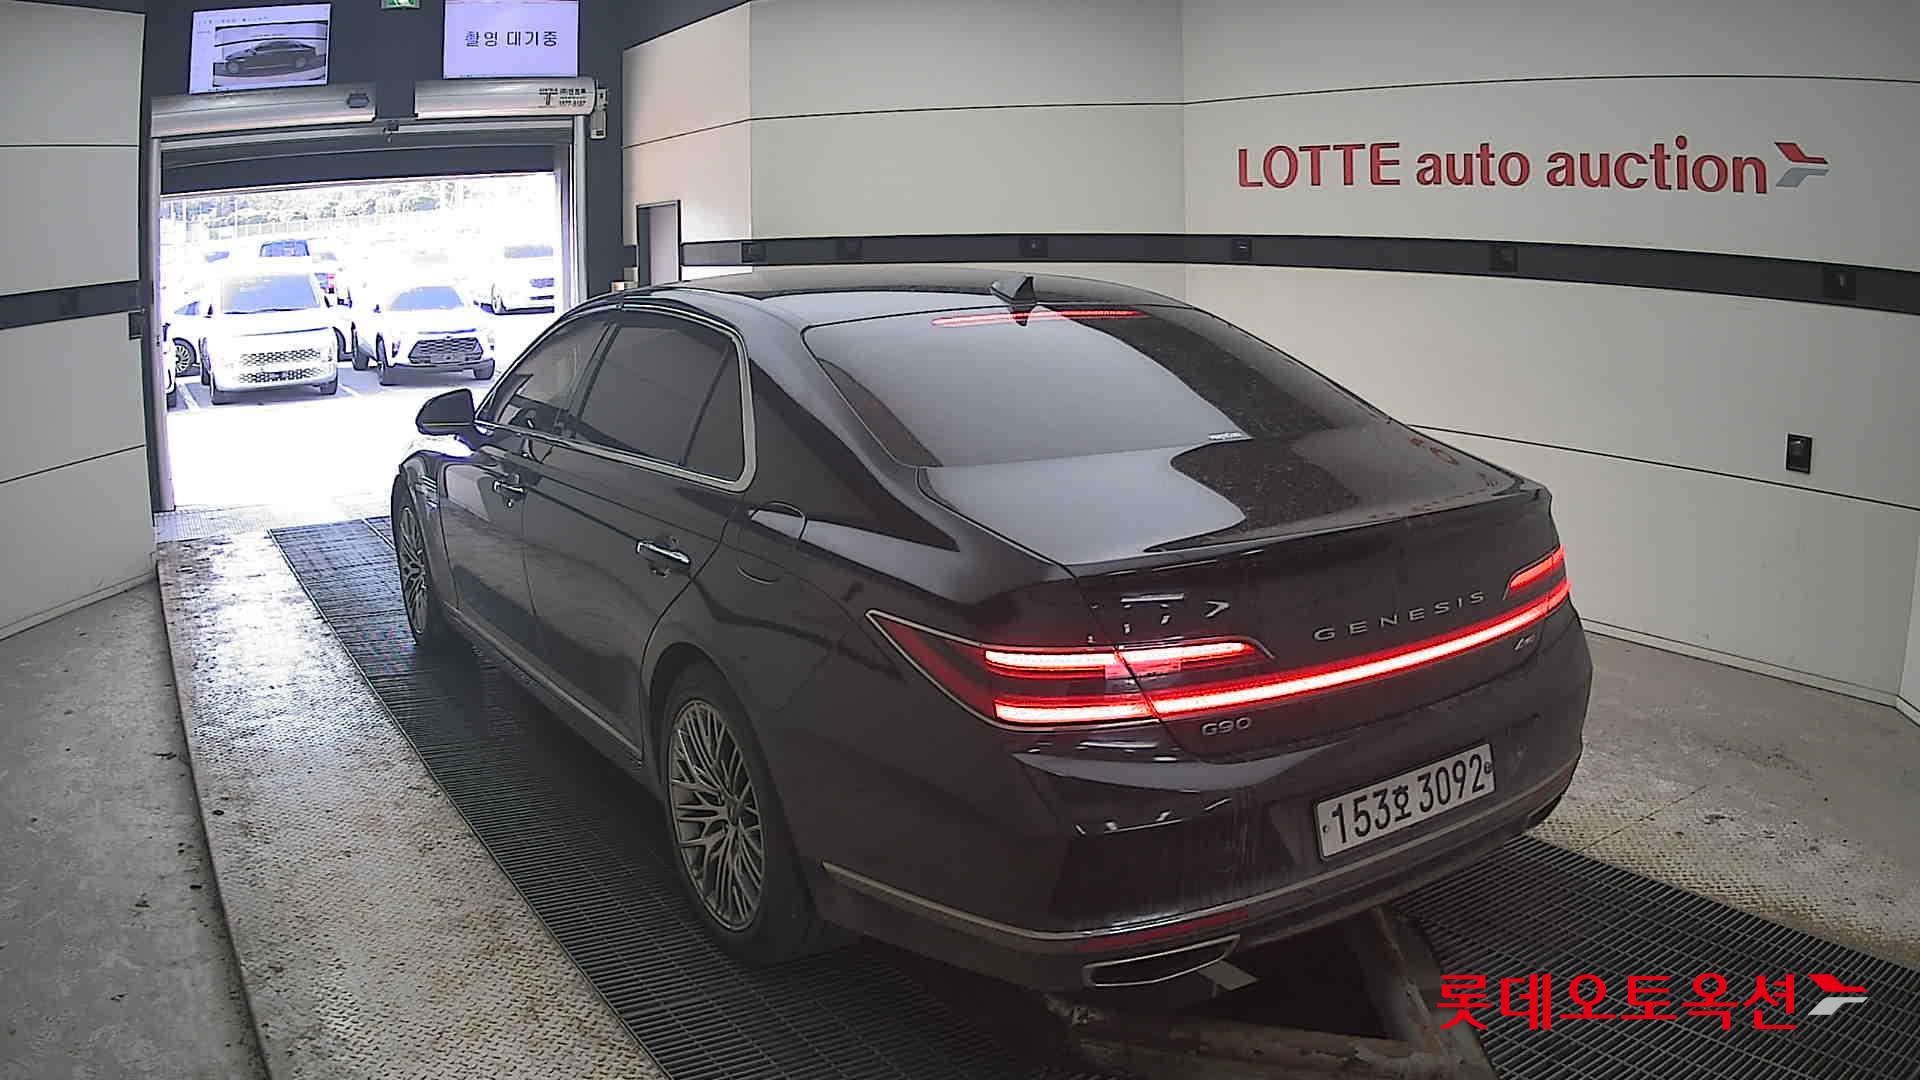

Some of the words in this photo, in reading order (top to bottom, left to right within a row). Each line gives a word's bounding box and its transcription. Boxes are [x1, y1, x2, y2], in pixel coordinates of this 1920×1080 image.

[506, 31, 557, 47] 대기중
[1238, 143, 1400, 188] LOTTE
[1416, 143, 1530, 187] auto
[1546, 136, 1767, 194] auction
[1314, 591, 1486, 641] GENESIS
[1202, 717, 1252, 736] G90
[1417, 753, 1485, 813] 3092
